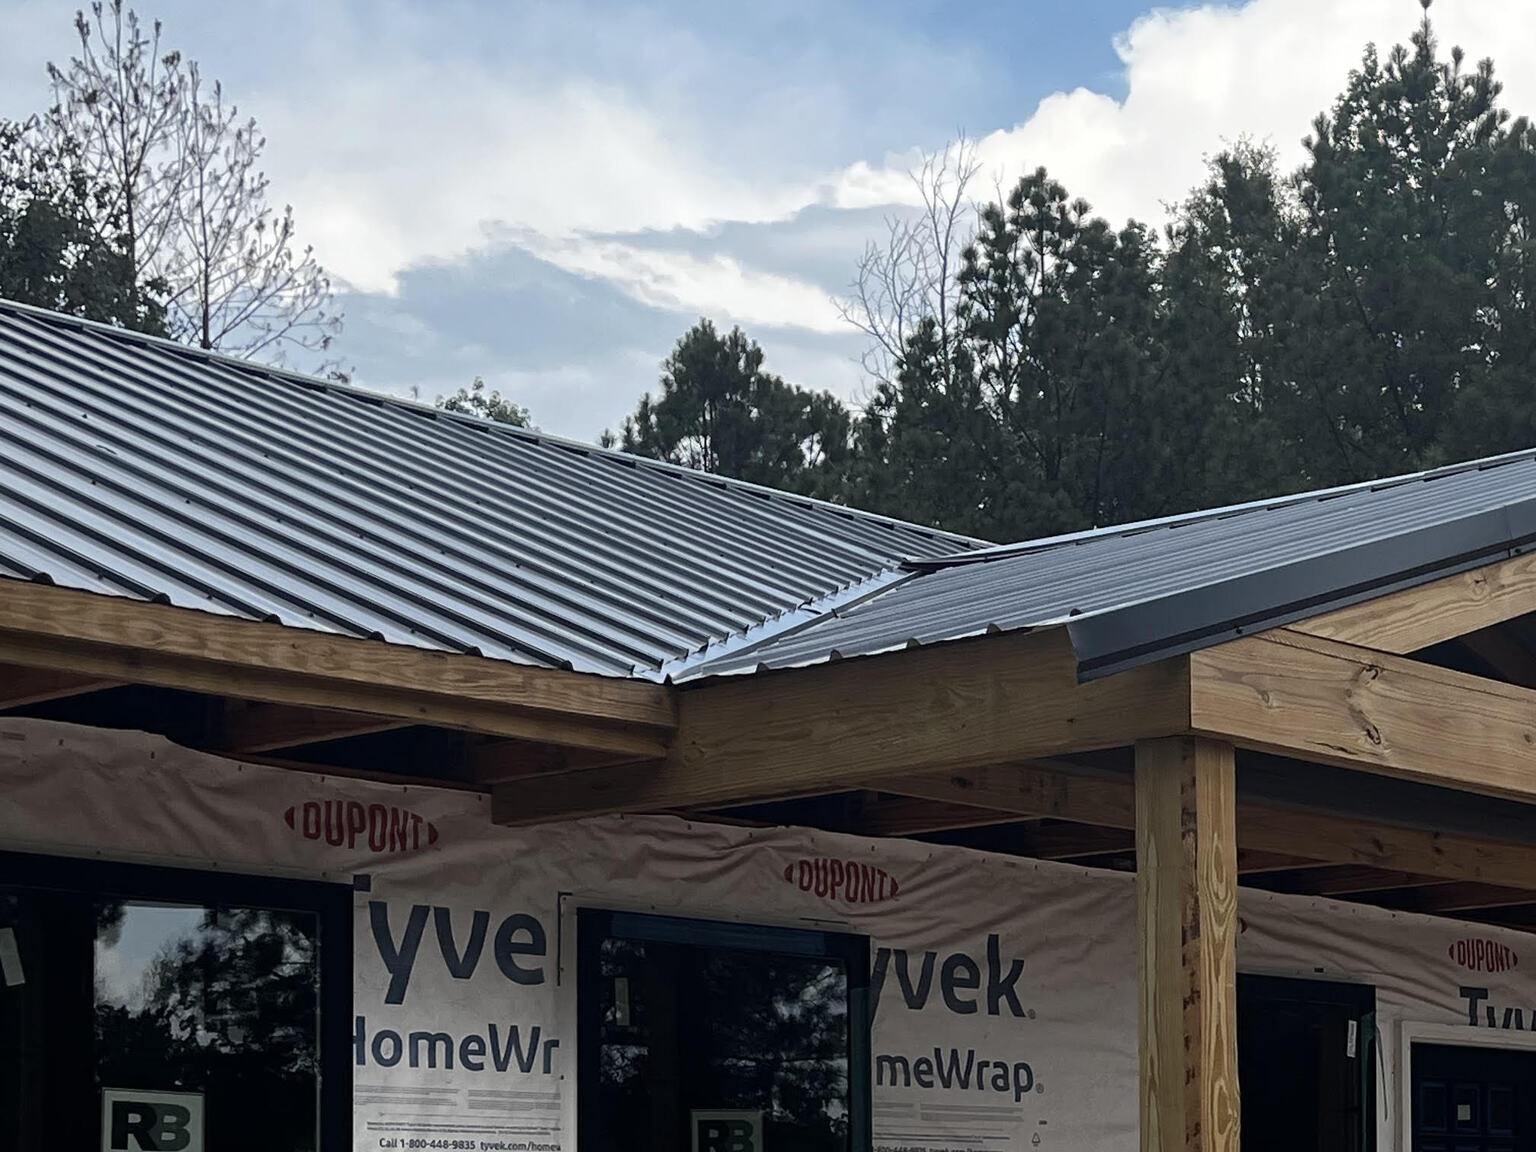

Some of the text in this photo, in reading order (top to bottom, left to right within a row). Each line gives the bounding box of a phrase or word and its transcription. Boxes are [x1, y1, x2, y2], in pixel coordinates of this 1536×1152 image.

[303, 801, 423, 852] DUPONT
[799, 859, 887, 903] DUPONT
[369, 901, 547, 1005] yve
[1457, 939, 1510, 972] DUPONT
[876, 1048, 1033, 1102] meWrap
[111, 1101, 190, 1151] RB
[379, 1138, 397, 1149] Call
[399, 1139, 476, 1151] 1-800-448-9835
